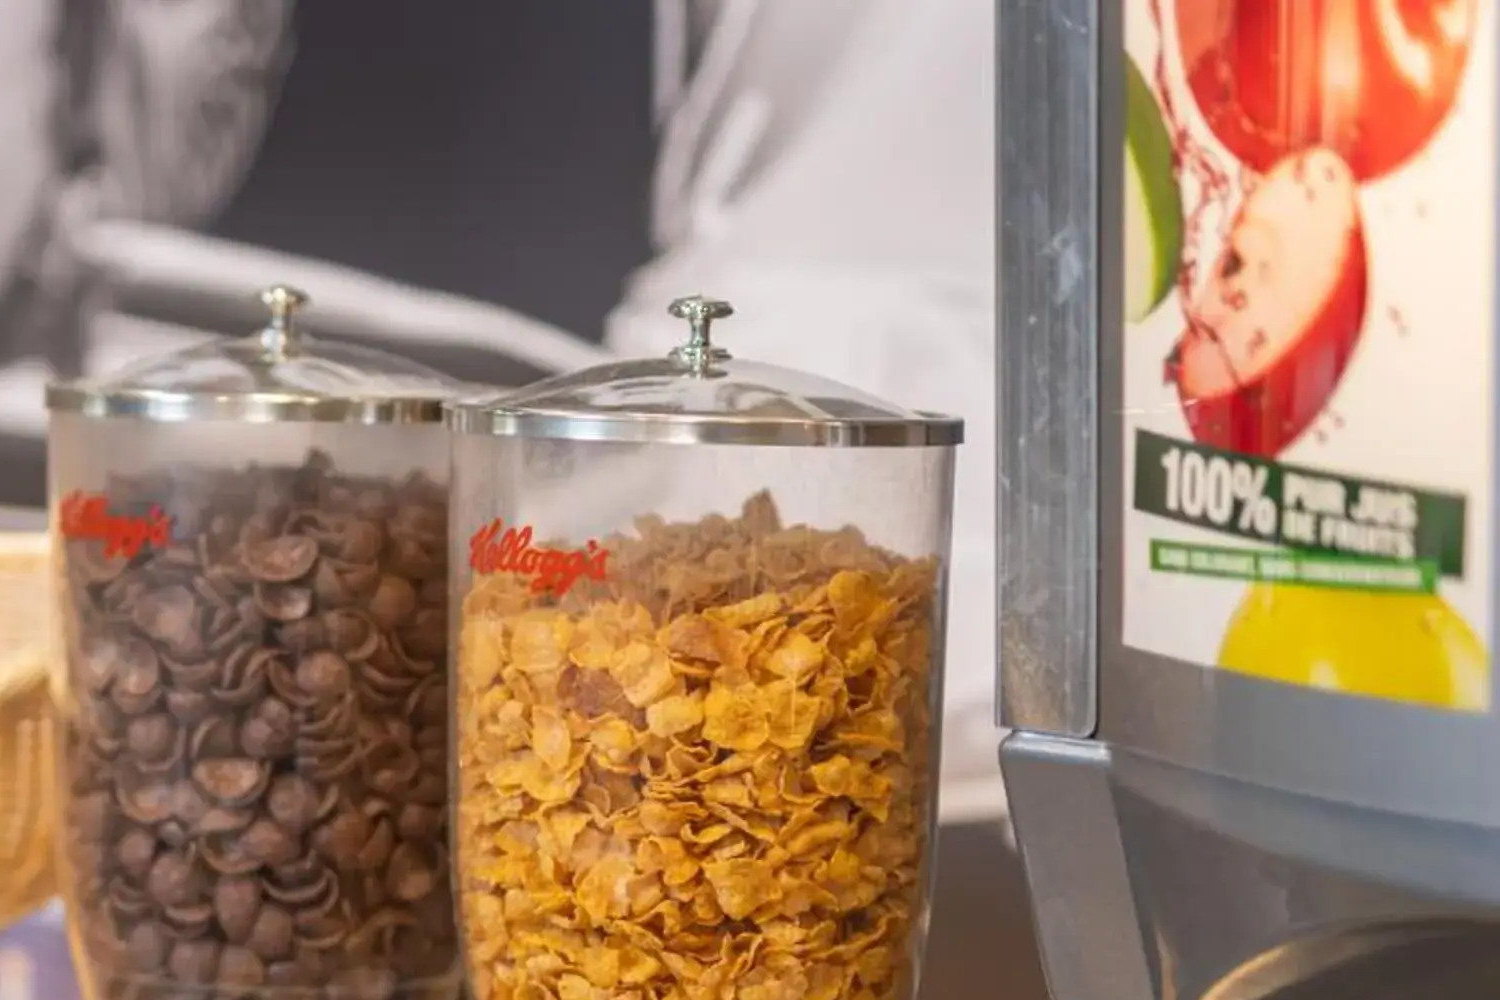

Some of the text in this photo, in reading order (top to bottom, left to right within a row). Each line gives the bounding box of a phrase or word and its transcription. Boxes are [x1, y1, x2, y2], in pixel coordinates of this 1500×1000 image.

[60, 489, 170, 560] Kellogg's
[1161, 447, 1417, 535] 100% PUR JUS
[469, 517, 611, 598] Kellogg's
[1282, 508, 1416, 560] DE FRUITS
